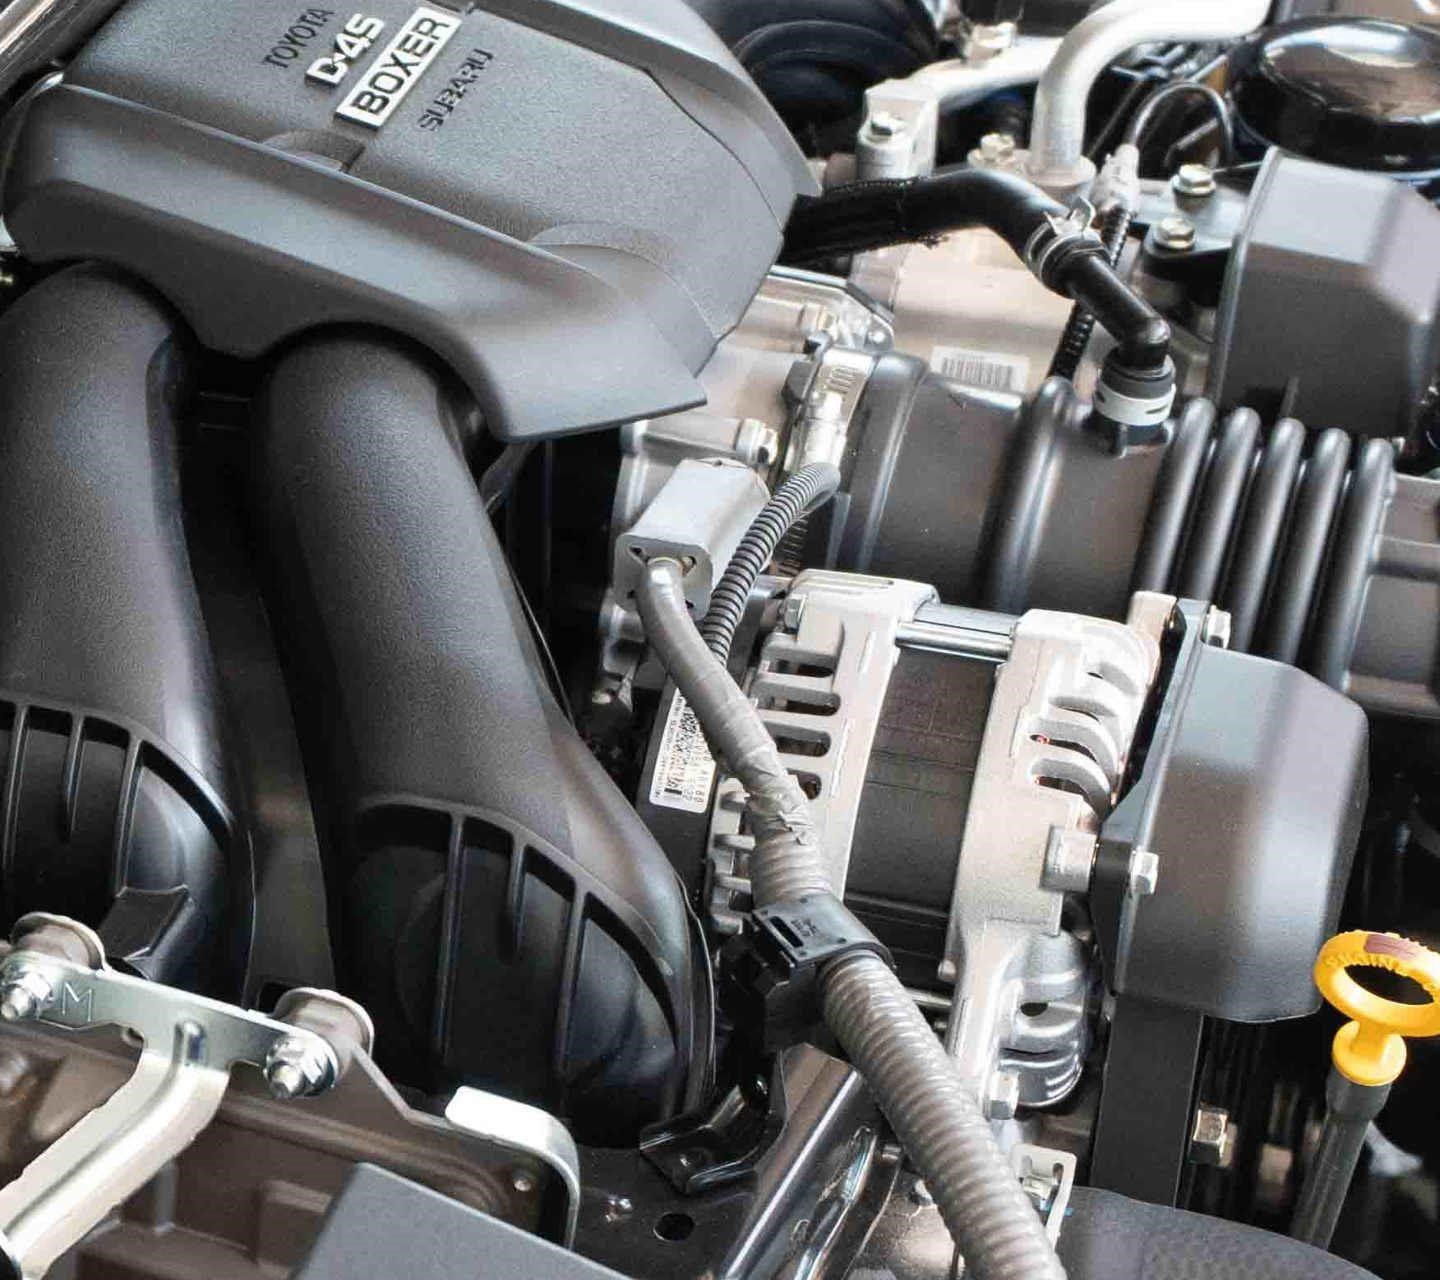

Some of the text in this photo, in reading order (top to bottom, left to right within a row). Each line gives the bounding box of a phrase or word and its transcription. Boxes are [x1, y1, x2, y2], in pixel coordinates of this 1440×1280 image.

[262, 8, 337, 69] TOYOTA
[351, 16, 451, 115] BOXER
[417, 47, 495, 132] SUBARU
